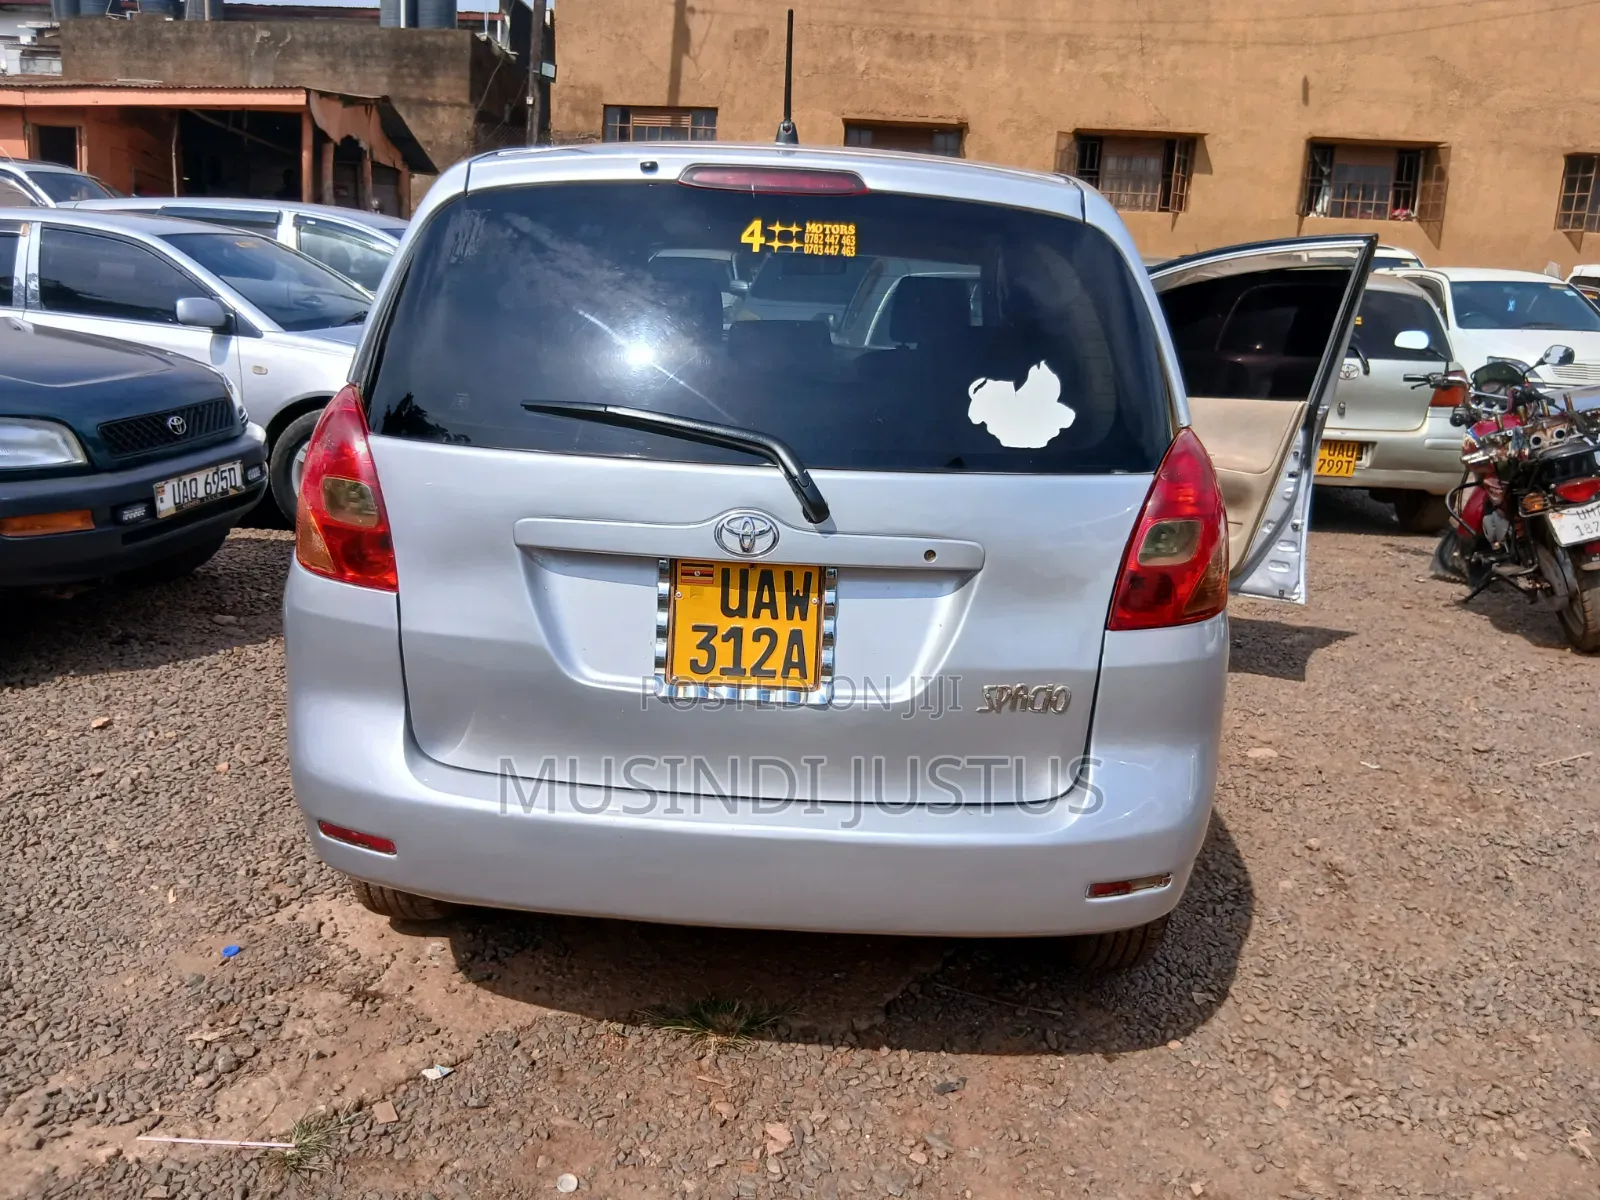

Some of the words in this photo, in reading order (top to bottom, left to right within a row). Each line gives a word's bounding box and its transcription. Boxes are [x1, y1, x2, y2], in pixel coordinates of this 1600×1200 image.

[741, 219, 765, 252] 4
[805, 222, 856, 234] MOTORS
[804, 233, 824, 244] 0782
[825, 234, 840, 245] 447
[841, 235, 856, 246] 463
[803, 244, 824, 255] 0703
[824, 245, 840, 256] 447
[841, 246, 856, 257] 463
[1328, 441, 1356, 458] UAU
[1317, 458, 1353, 474] 799T
[172, 477, 199, 506] UAQ
[204, 467, 238, 496] 695D
[720, 567, 813, 621] UAW
[689, 624, 808, 679] 312A
